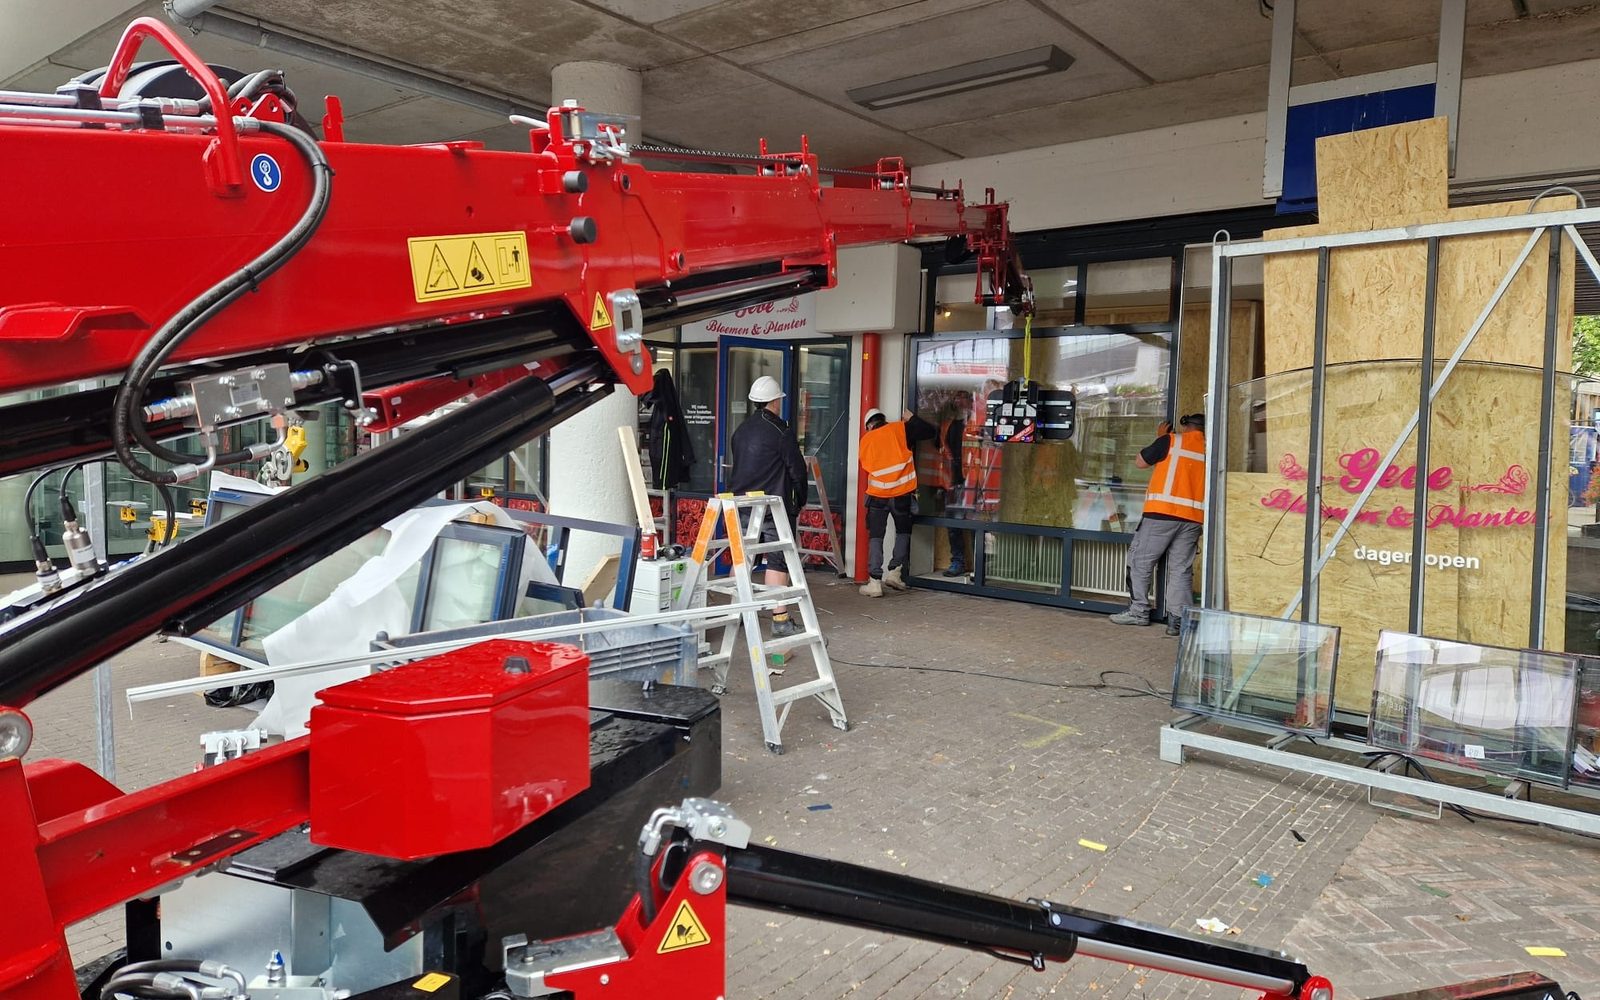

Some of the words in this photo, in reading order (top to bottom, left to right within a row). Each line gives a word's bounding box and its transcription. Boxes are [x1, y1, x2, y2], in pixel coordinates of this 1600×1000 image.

[706, 319, 749, 336] Bloemen
[751, 323, 761, 336] &
[763, 318, 807, 335] Planten
[1425, 553, 1480, 570] open
